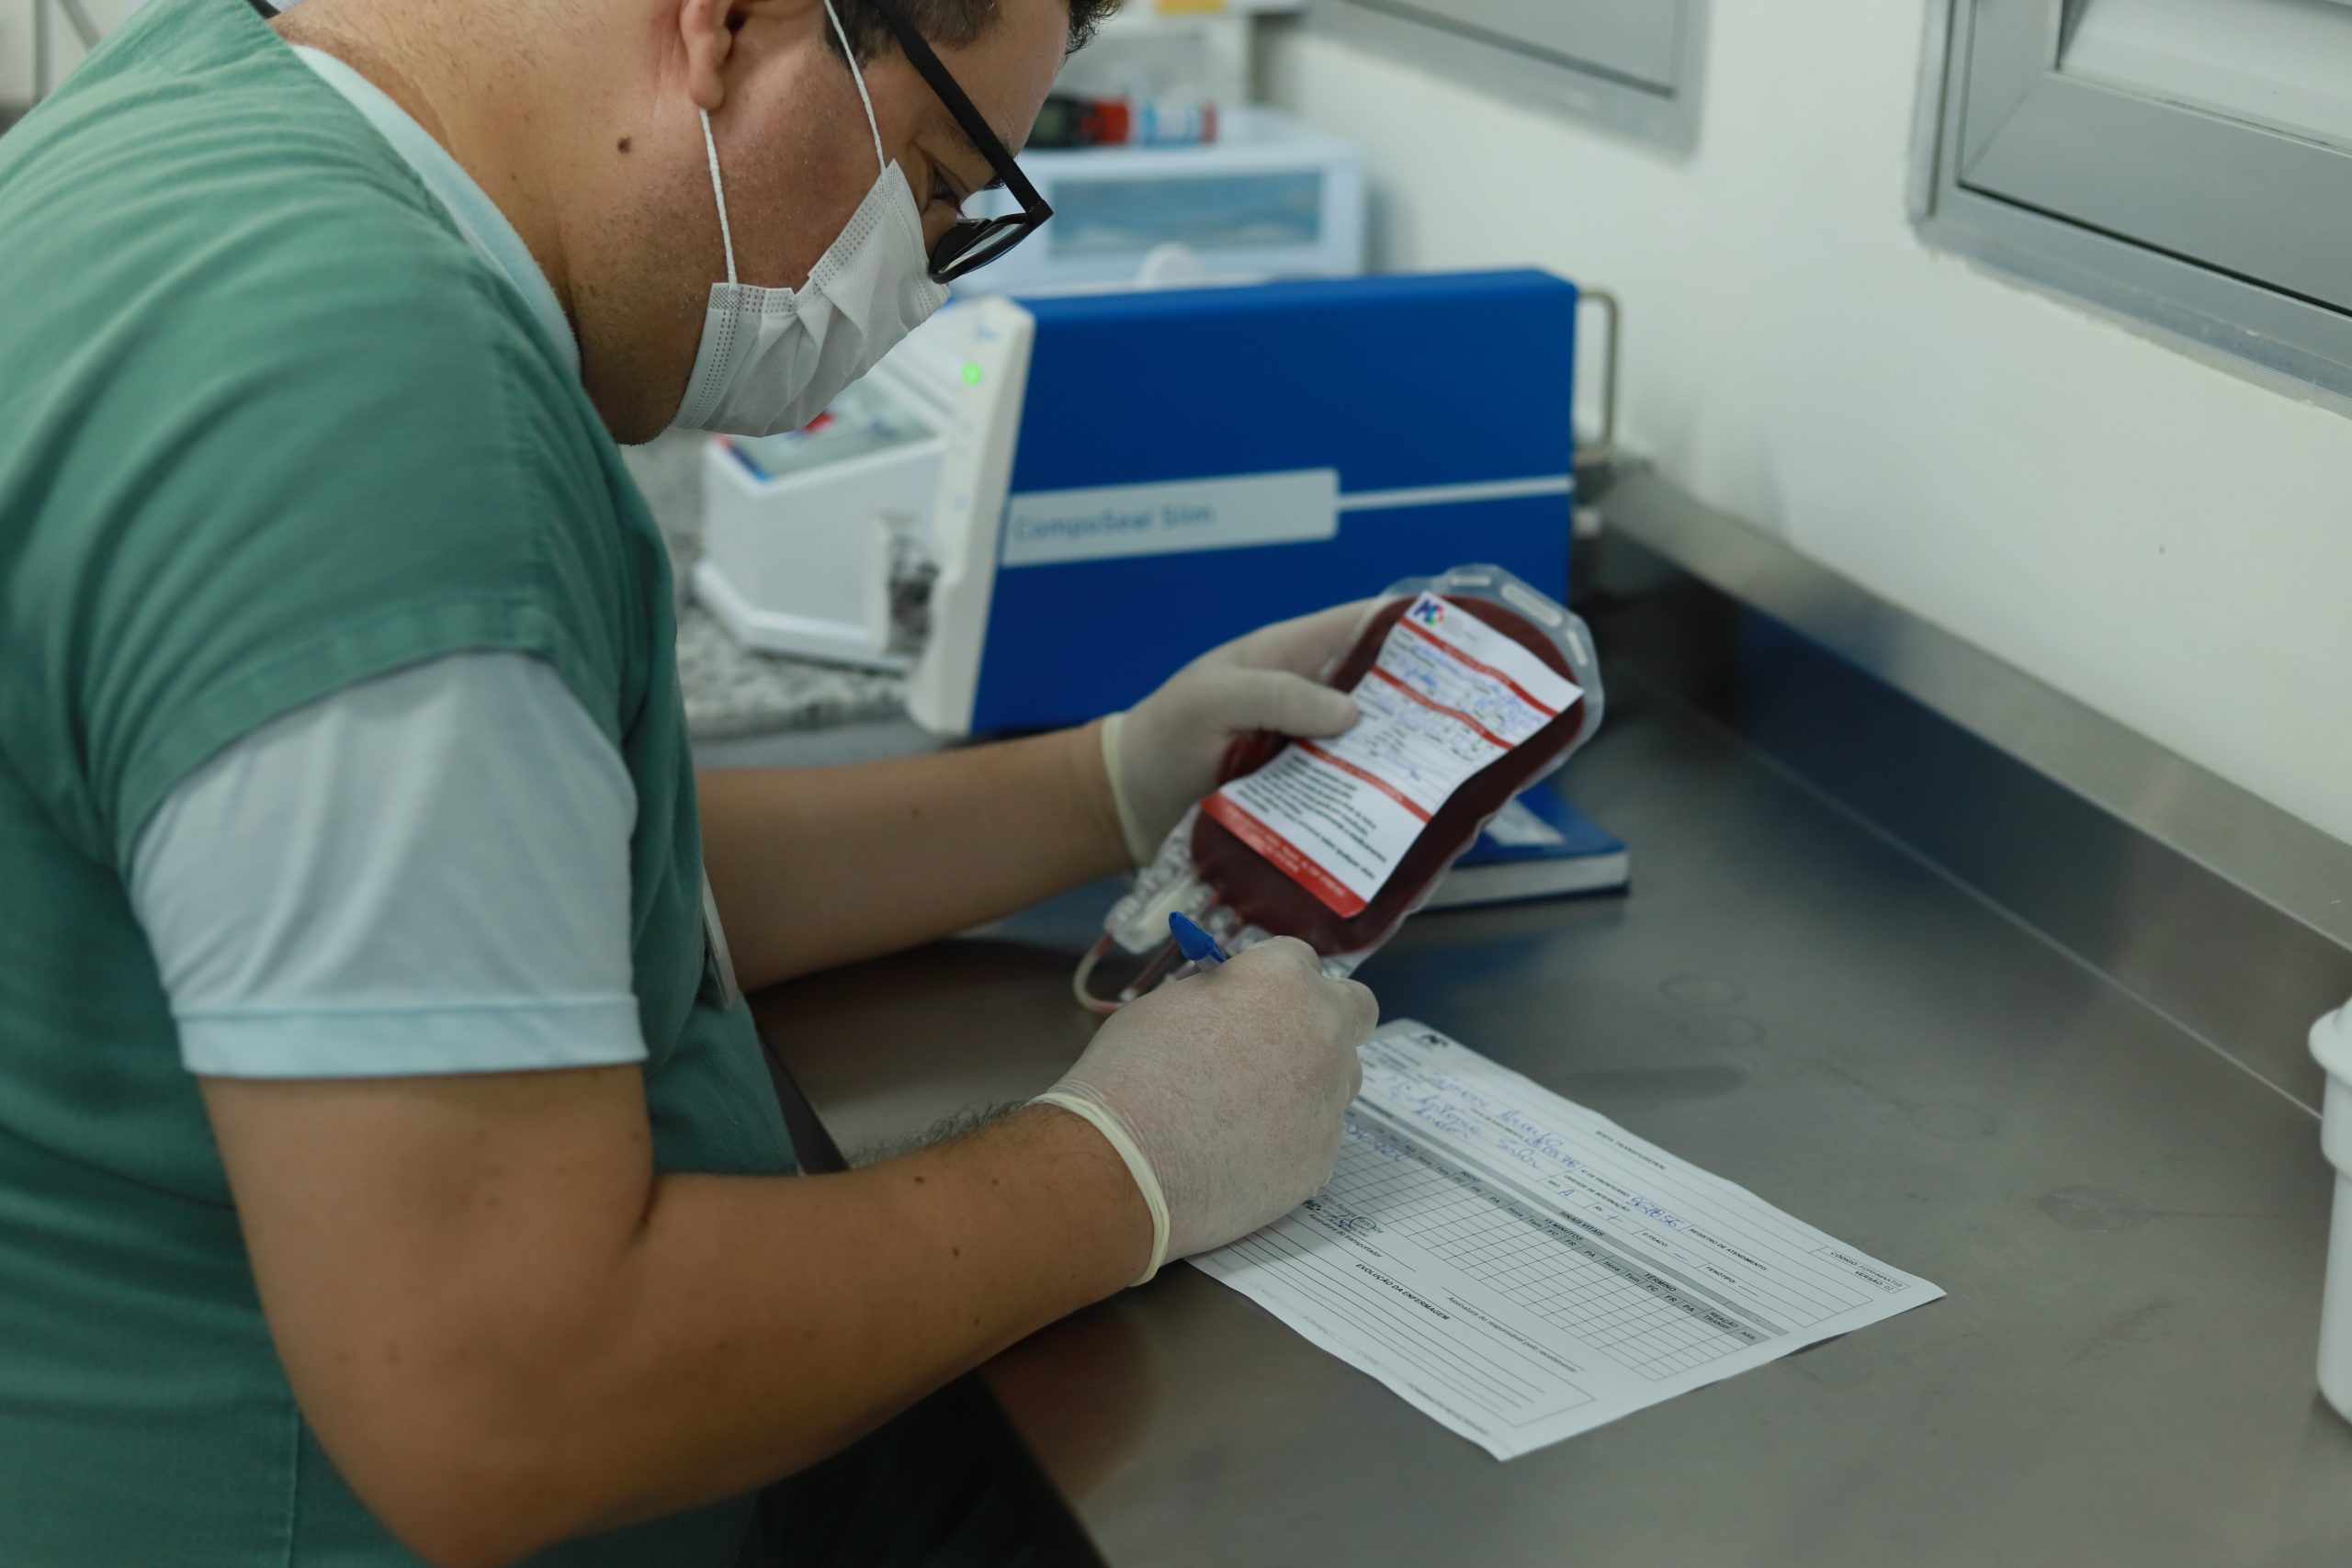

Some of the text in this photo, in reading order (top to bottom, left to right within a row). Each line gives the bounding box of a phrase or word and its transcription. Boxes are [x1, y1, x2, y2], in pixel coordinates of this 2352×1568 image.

[1306, 1213, 1341, 1232] Assinatura
[1544, 1228, 1561, 1236] FC
[1686, 1227, 1719, 1245] REGISTRO
[1562, 1238, 1578, 1247] FR
[1581, 1249, 1600, 1258] PA
[1353, 1262, 1453, 1321] EVOLUÇÃO DA ENFERMAGEM
[1644, 1283, 1661, 1292] FC
[1663, 1293, 1679, 1302] FR
[1444, 1295, 1482, 1316] Assinatura
[1680, 1303, 1698, 1312] PA
